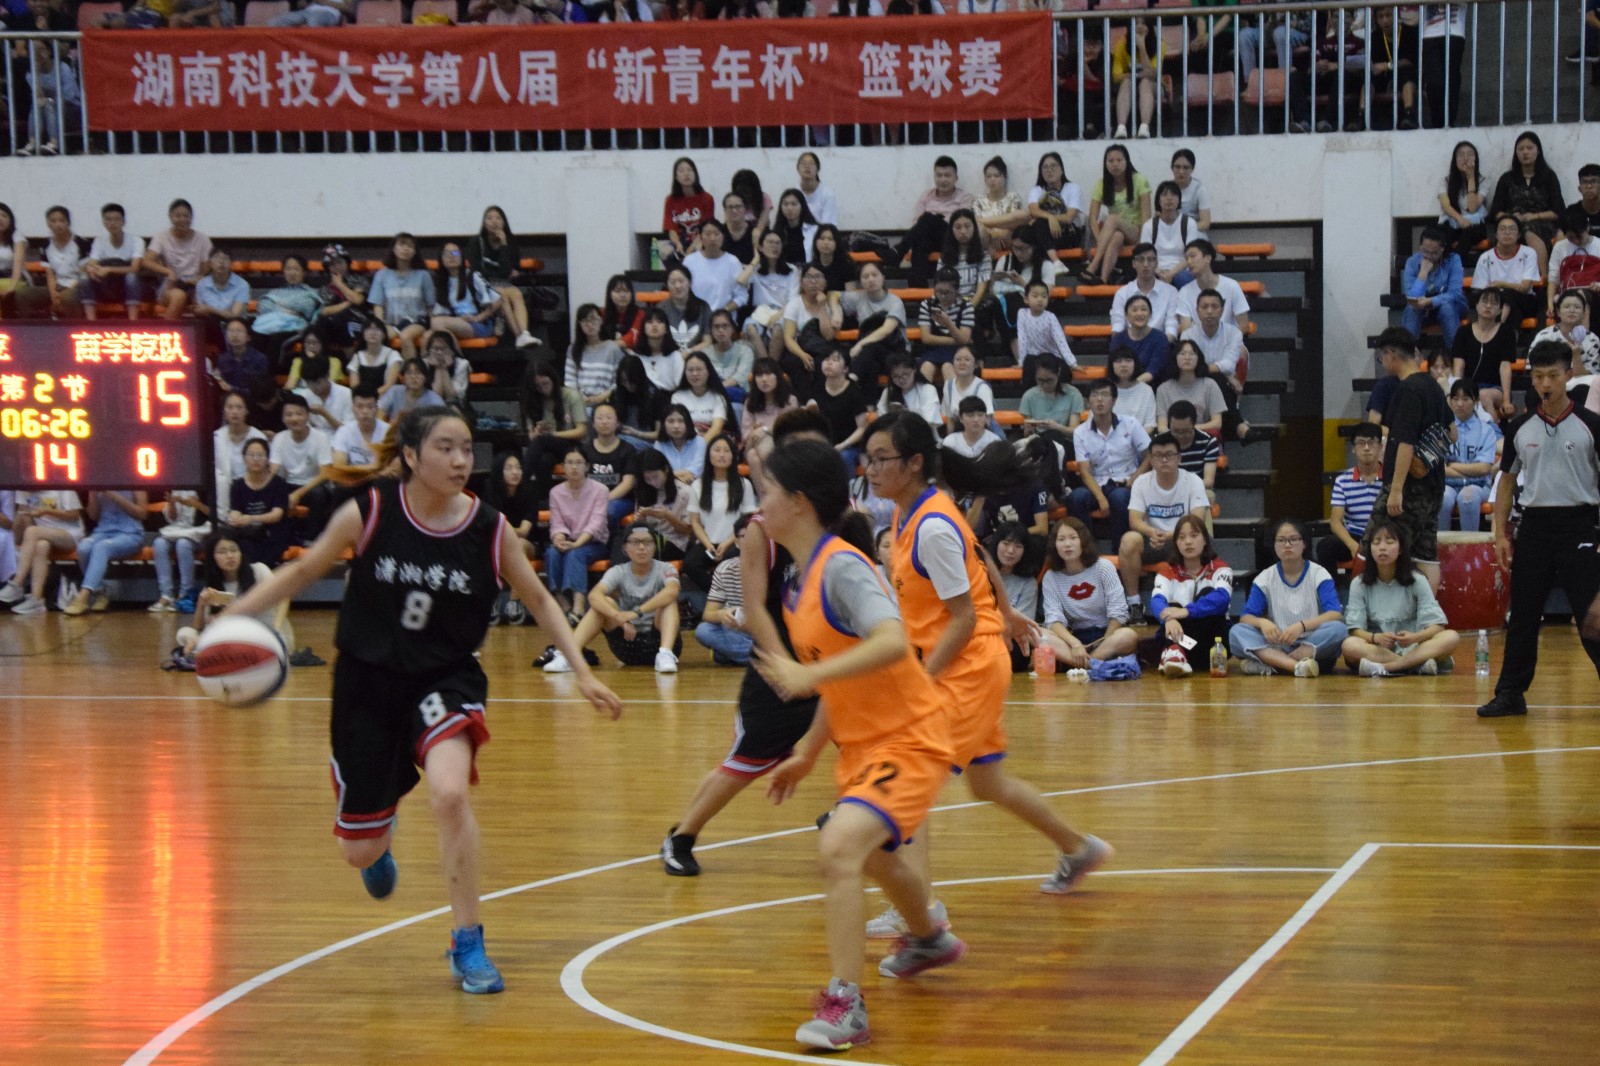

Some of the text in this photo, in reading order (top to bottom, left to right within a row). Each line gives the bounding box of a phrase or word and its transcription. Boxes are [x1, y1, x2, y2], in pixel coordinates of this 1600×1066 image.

[131, 38, 1003, 107] 湖南科技大学第八届 “新青年杯” 篮球赛
[71, 331, 190, 362] 商学院队
[139, 371, 189, 425] 15
[1, 408, 90, 437] 06:26
[35, 443, 77, 481] 14
[137, 447, 158, 476] 0
[401, 591, 432, 631] 8
[419, 692, 447, 726] 8
